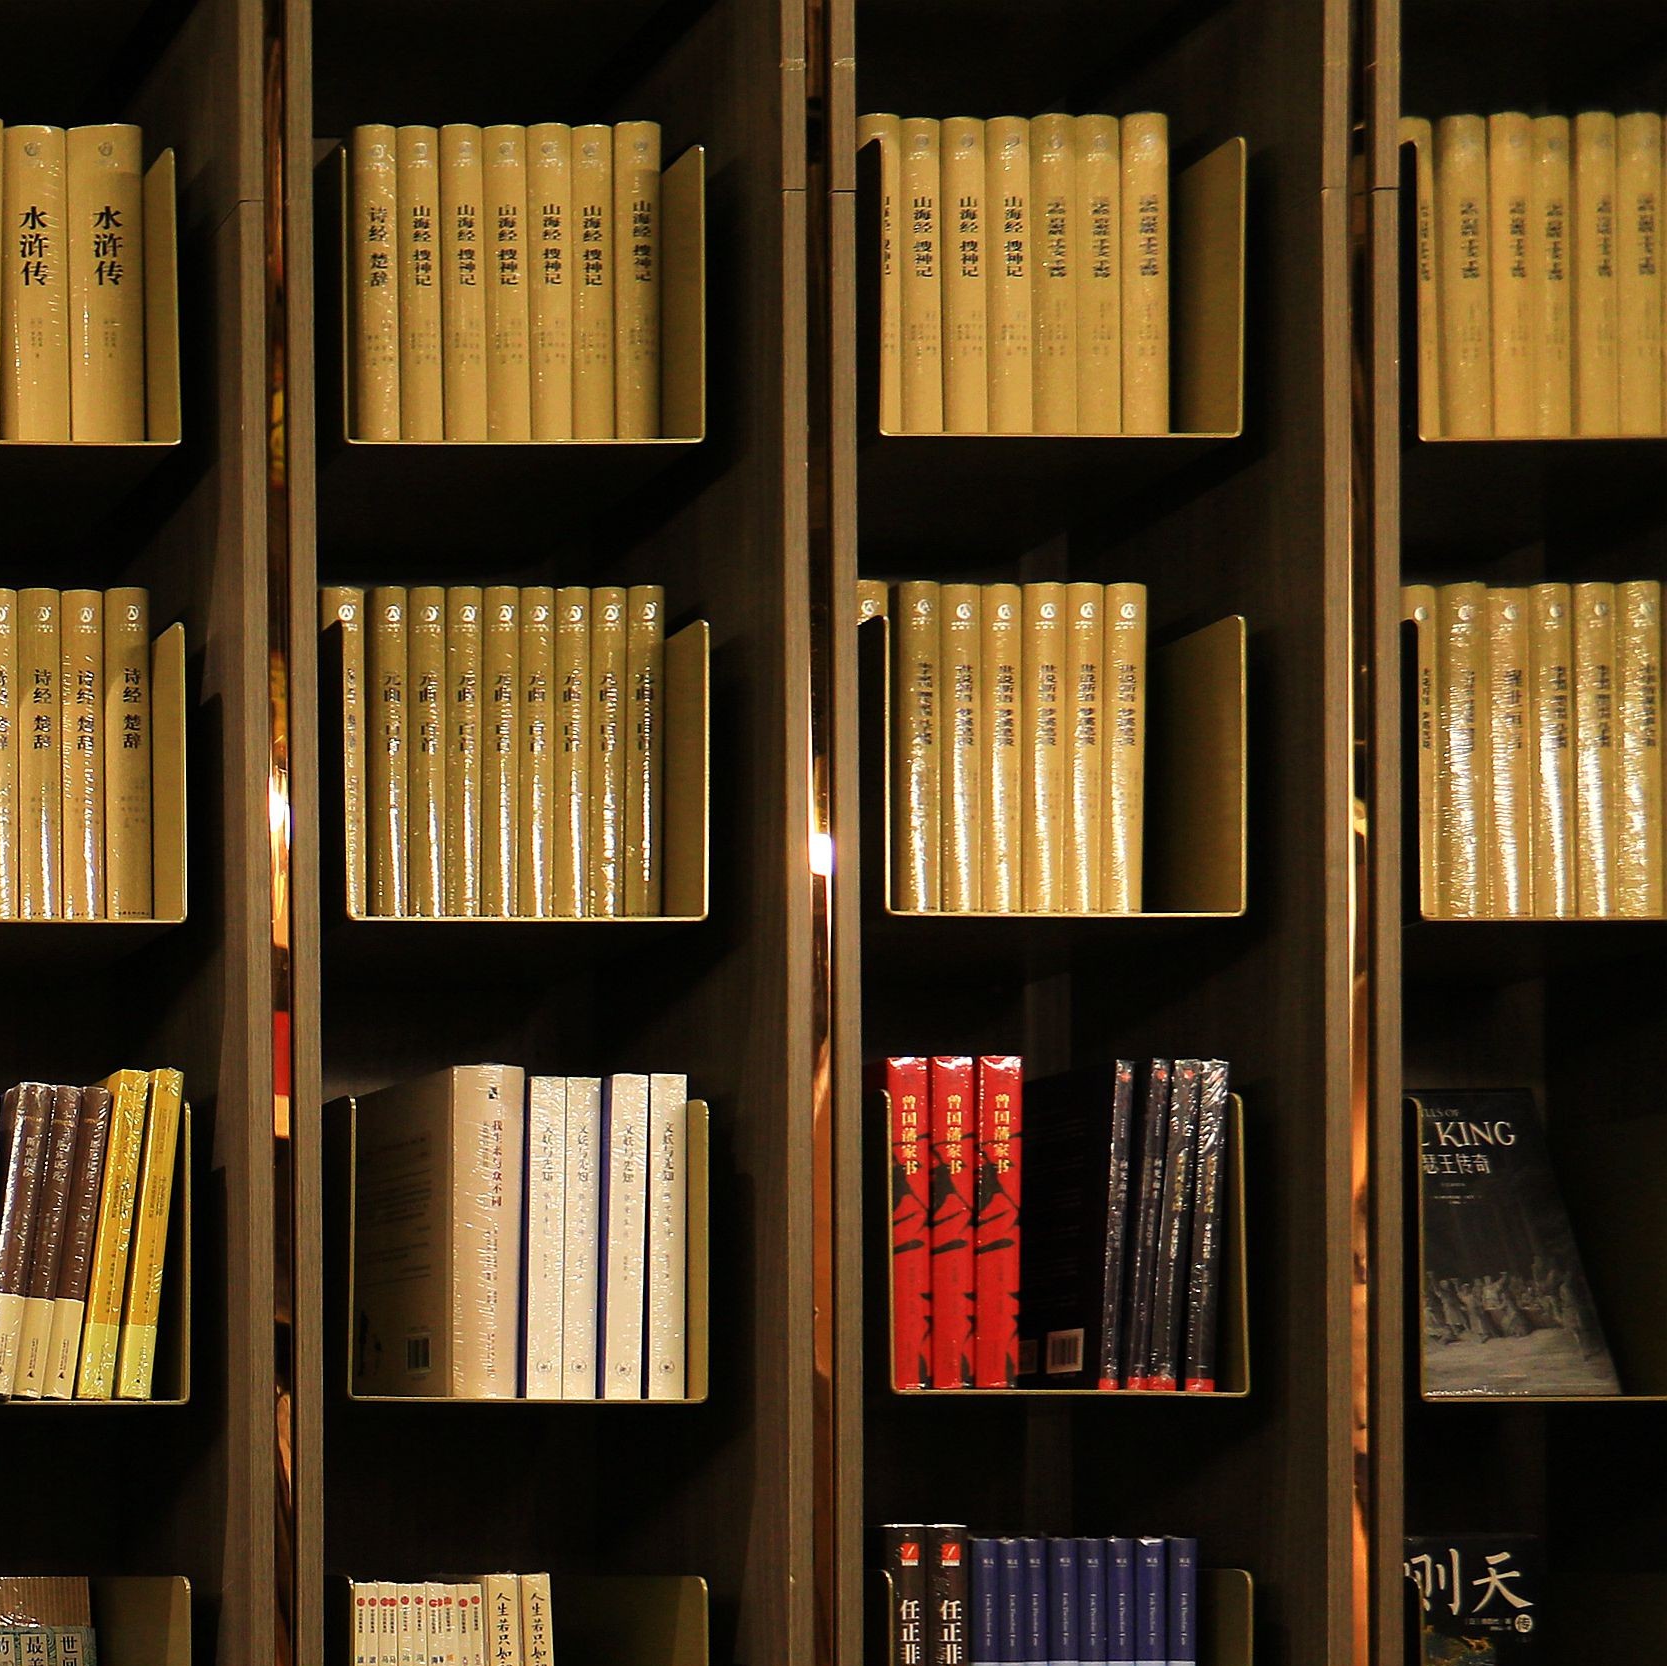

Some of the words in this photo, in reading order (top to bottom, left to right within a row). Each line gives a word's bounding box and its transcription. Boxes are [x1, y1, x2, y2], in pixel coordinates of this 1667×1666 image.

[368, 206, 388, 242] 诗经
[543, 204, 561, 241] 山海经
[19, 206, 49, 286] 水浒传
[93, 206, 123, 286] 水浒传
[369, 252, 388, 287] 楚辞
[543, 248, 561, 285] 搜神记
[33, 669, 52, 704] 诗经
[123, 668, 142, 704] 诗经
[33, 714, 52, 749] 楚辞
[123, 714, 142, 749] 楚辞
[901, 1095, 917, 1175] 曾国藩家书
[947, 1095, 962, 1174] 曾国藩家书
[995, 1094, 1010, 1173] 曾国藩家书
[1435, 1121, 1515, 1147] KING
